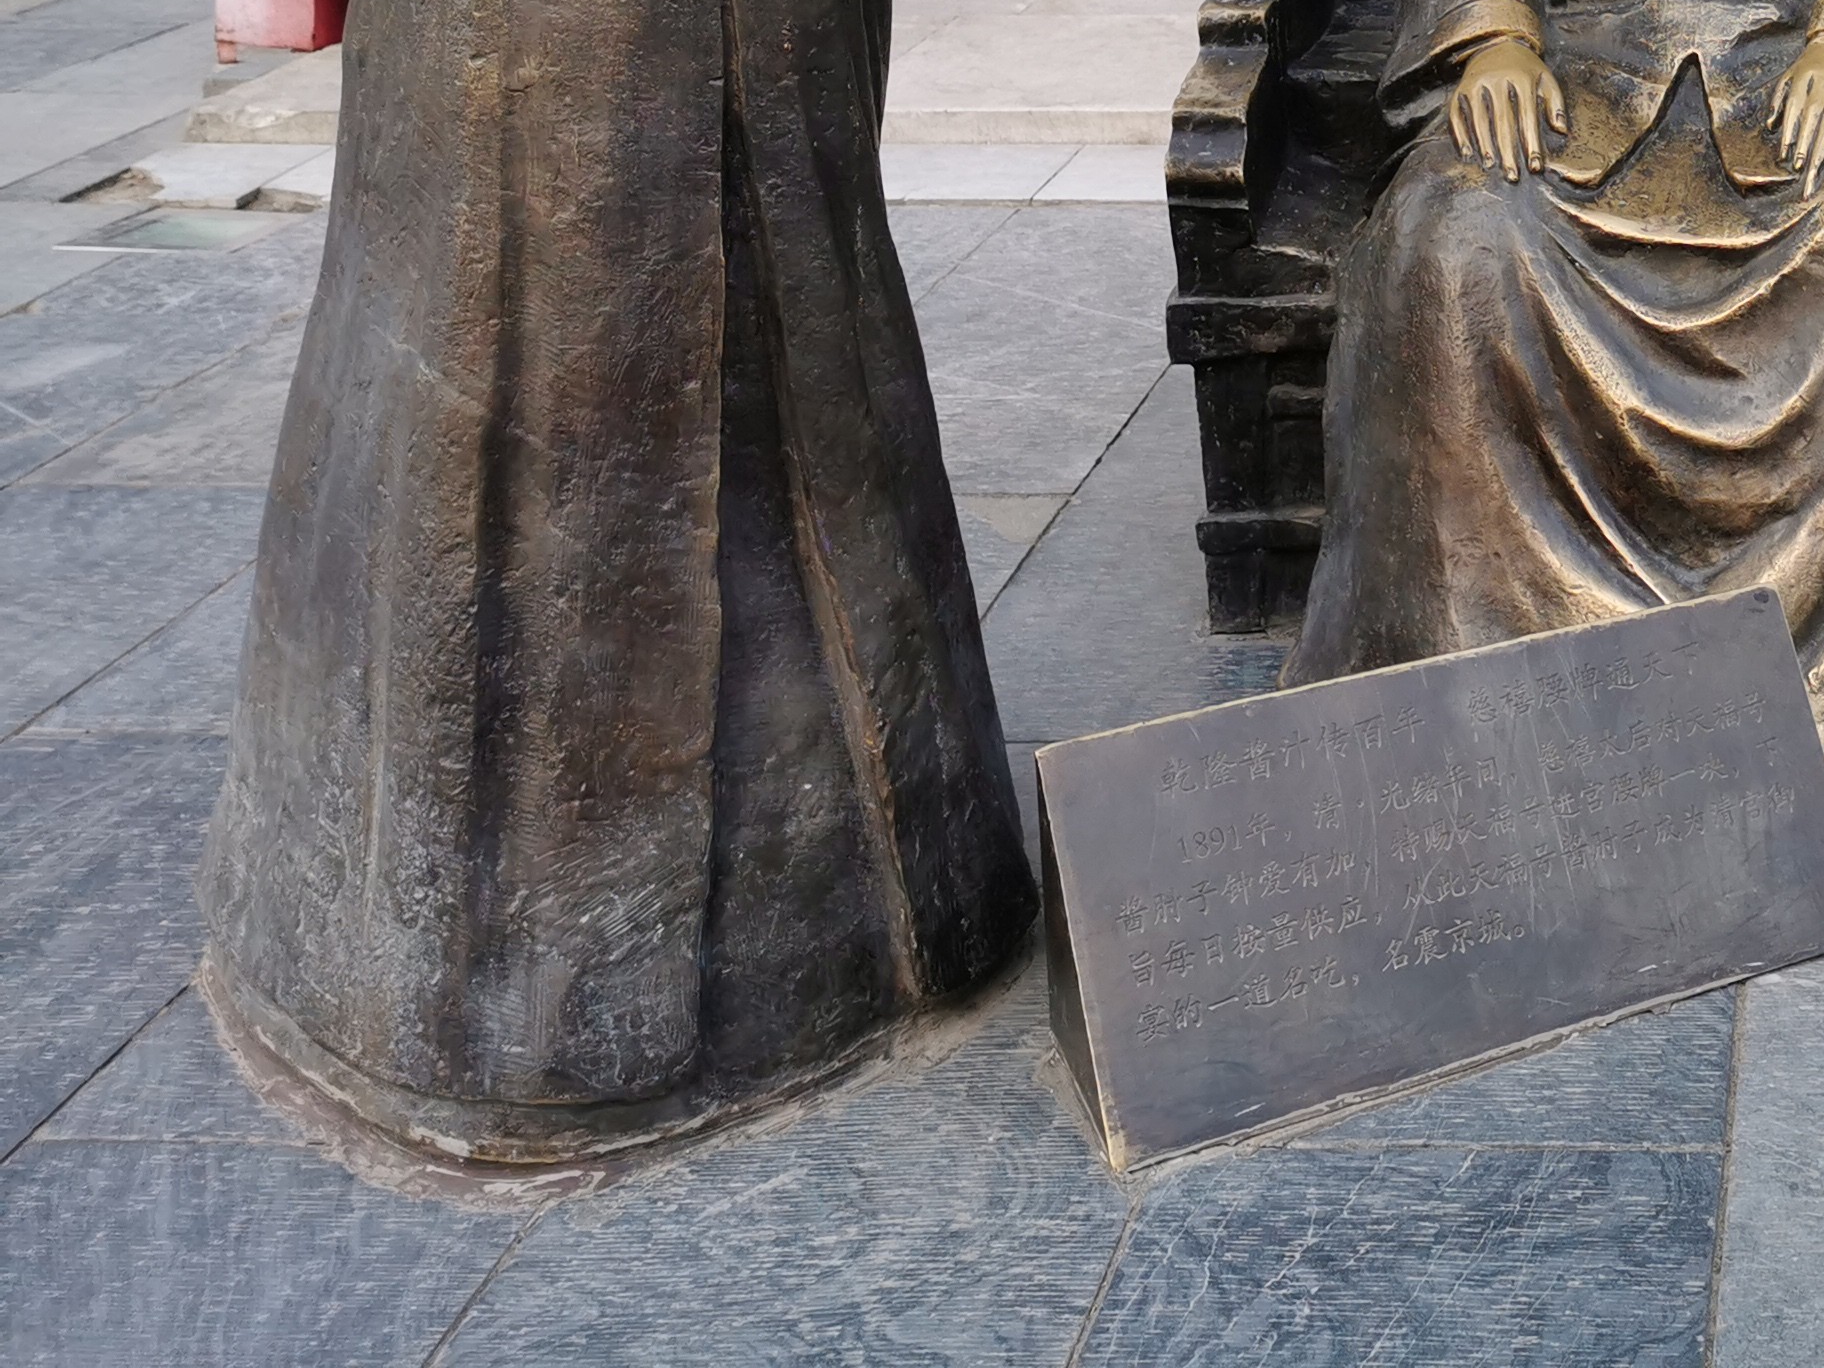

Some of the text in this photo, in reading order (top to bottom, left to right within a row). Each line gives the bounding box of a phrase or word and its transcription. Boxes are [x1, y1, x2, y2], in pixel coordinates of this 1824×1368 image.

[1159, 638, 1700, 800] 乾隆酱汁传百年 慈禧腰牌通天下
